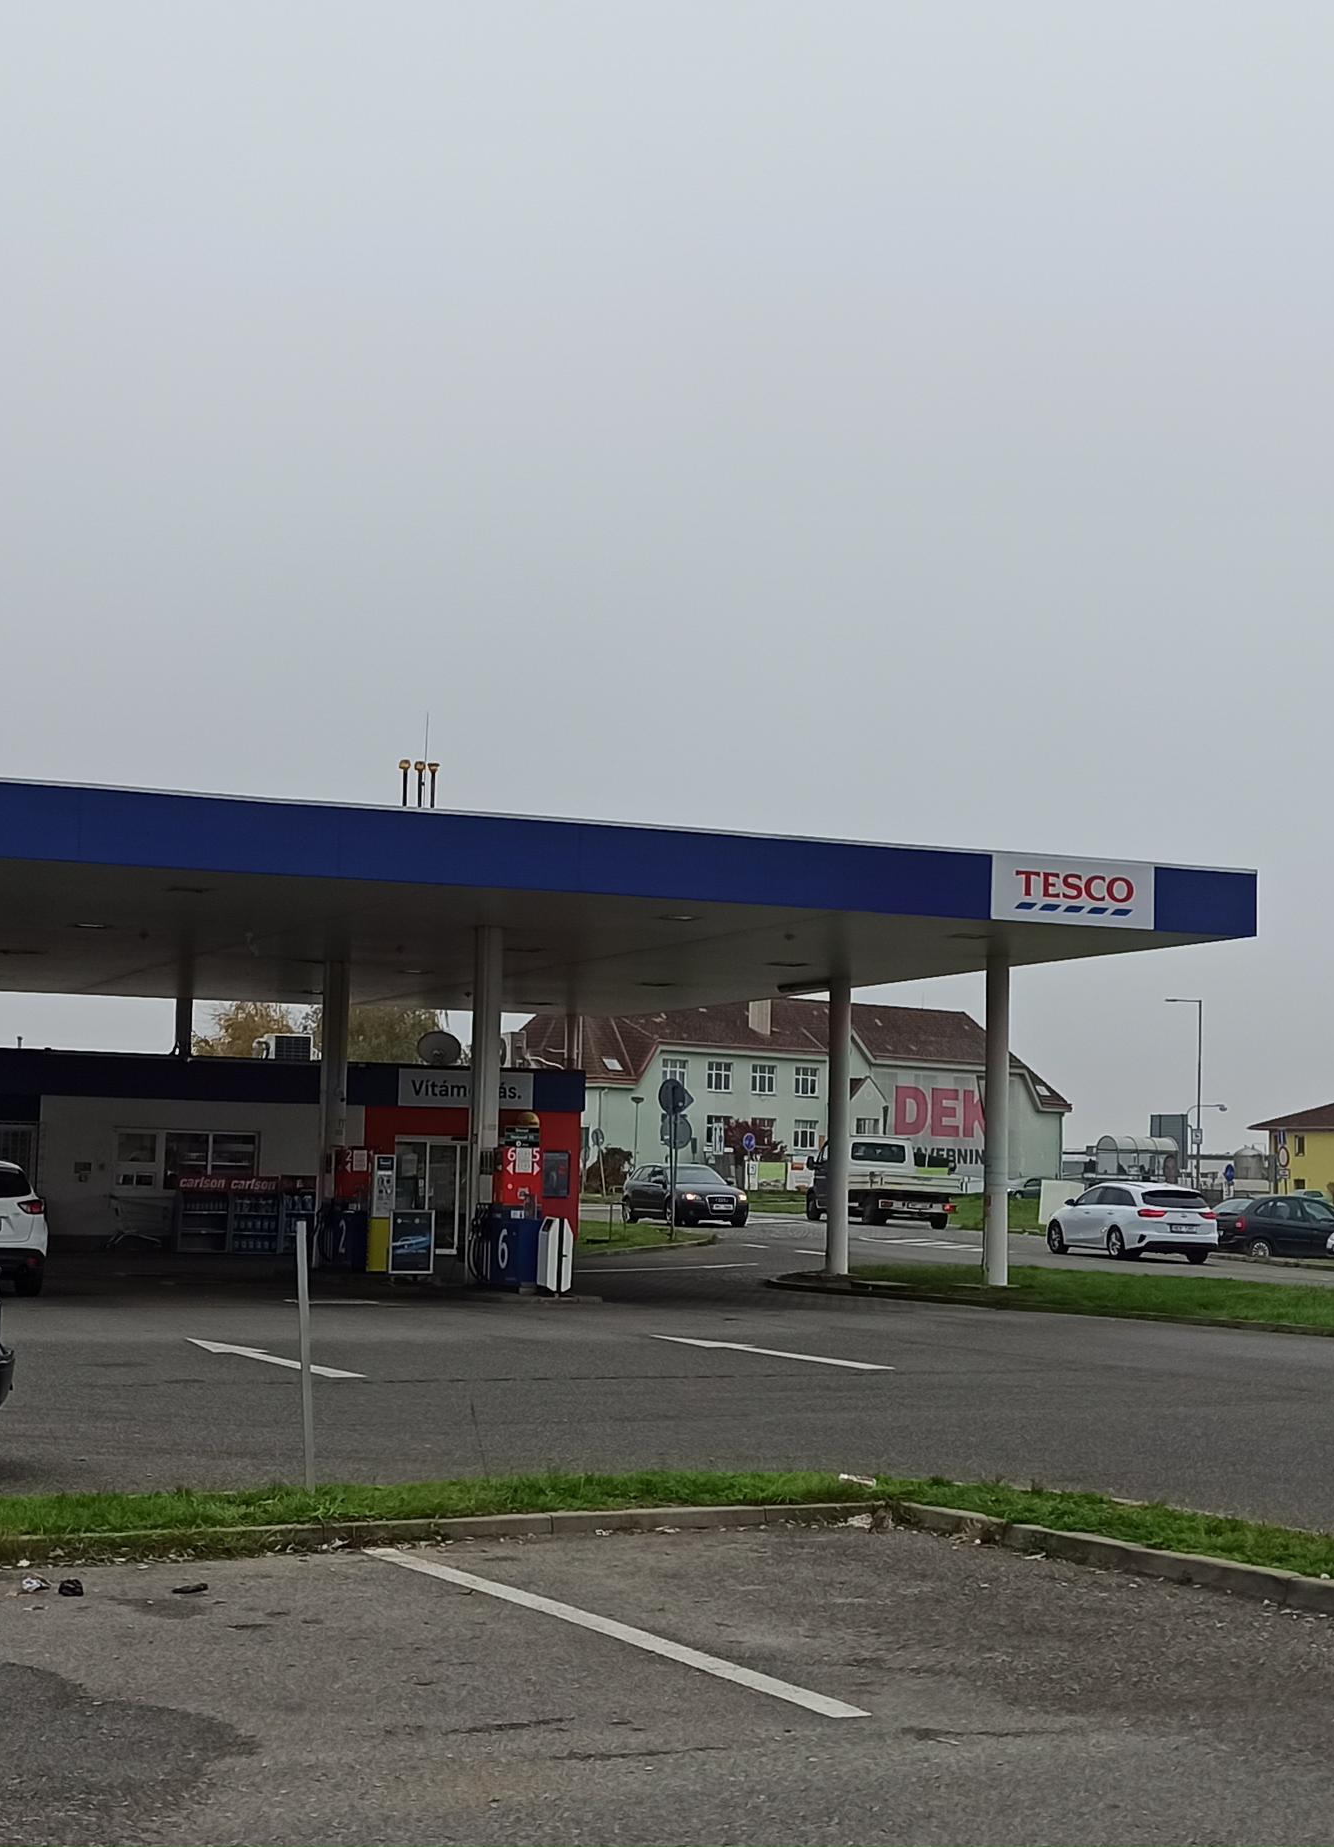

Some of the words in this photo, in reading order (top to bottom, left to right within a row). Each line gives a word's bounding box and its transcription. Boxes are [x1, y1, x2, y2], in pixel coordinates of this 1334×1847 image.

[1015, 869, 1134, 903] TESCO
[411, 1079, 471, 1098] Vítám
[498, 1082, 522, 1100] ás.
[346, 1150, 352, 1162] 2
[507, 1147, 516, 1161] 6
[533, 1147, 540, 1161] 5
[179, 1177, 225, 1189] carlson
[230, 1178, 276, 1191] carlson
[338, 1219, 346, 1254] 2
[498, 1228, 508, 1270] 6
